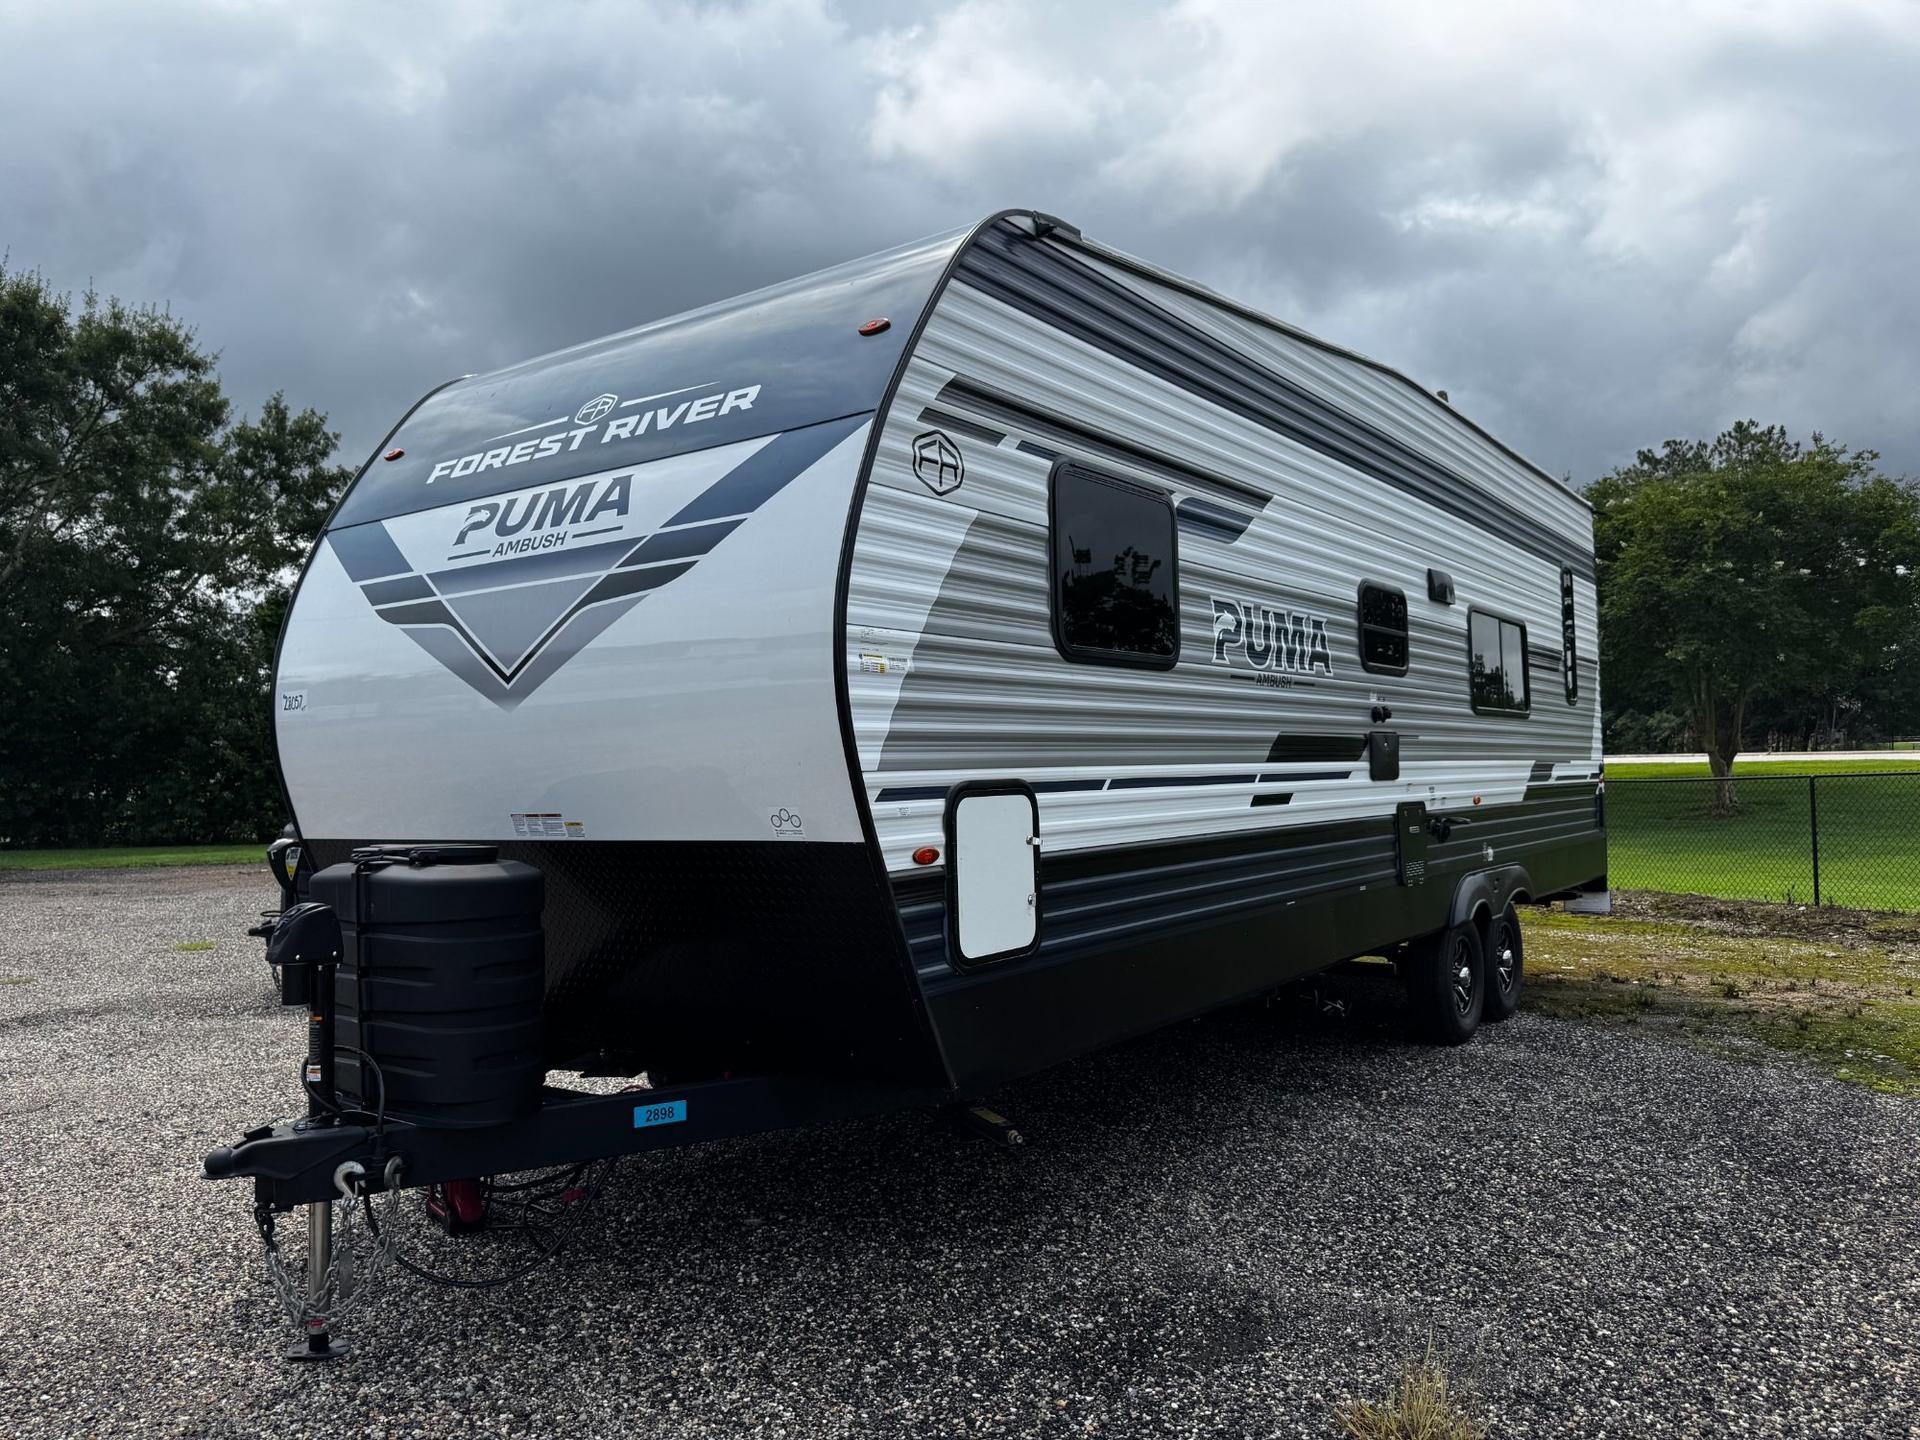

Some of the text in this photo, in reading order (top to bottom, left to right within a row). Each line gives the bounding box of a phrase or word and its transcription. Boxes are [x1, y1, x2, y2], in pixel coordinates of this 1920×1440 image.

[425, 383, 762, 485] FOREST RIVER
[451, 474, 635, 547] PUMA
[492, 531, 569, 558] AMBUSH
[1210, 595, 1333, 677] PUMA
[1256, 673, 1293, 689] AMBUSH
[645, 1106, 675, 1122] 2898
